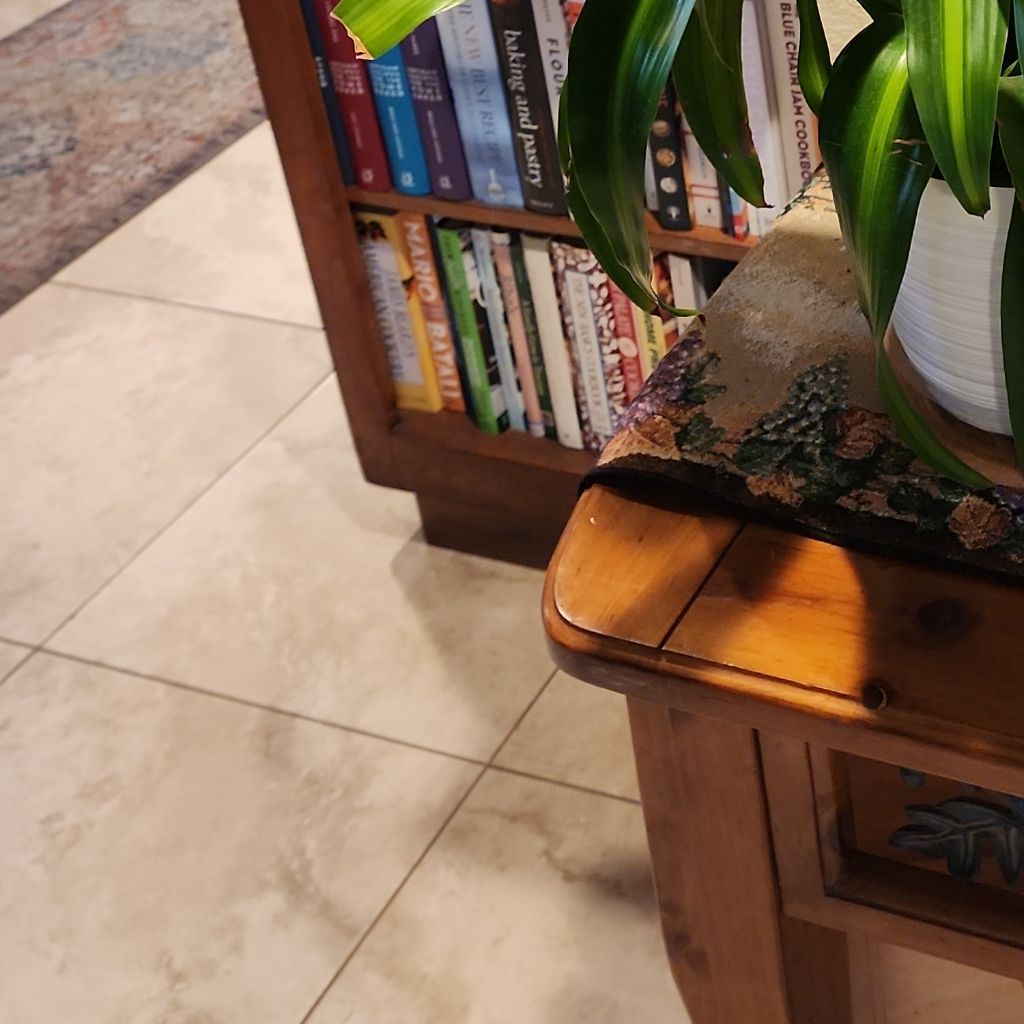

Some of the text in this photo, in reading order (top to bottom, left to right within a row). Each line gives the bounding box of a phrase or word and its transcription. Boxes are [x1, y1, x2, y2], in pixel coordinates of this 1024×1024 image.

[504, 29, 528, 91] baking
[510, 93, 538, 132] and
[780, 1, 813, 182] BLUE CHAIR JAM COOKBO
[516, 131, 543, 189] pastry
[403, 222, 438, 303] MARIO
[426, 321, 463, 399] BATALI
